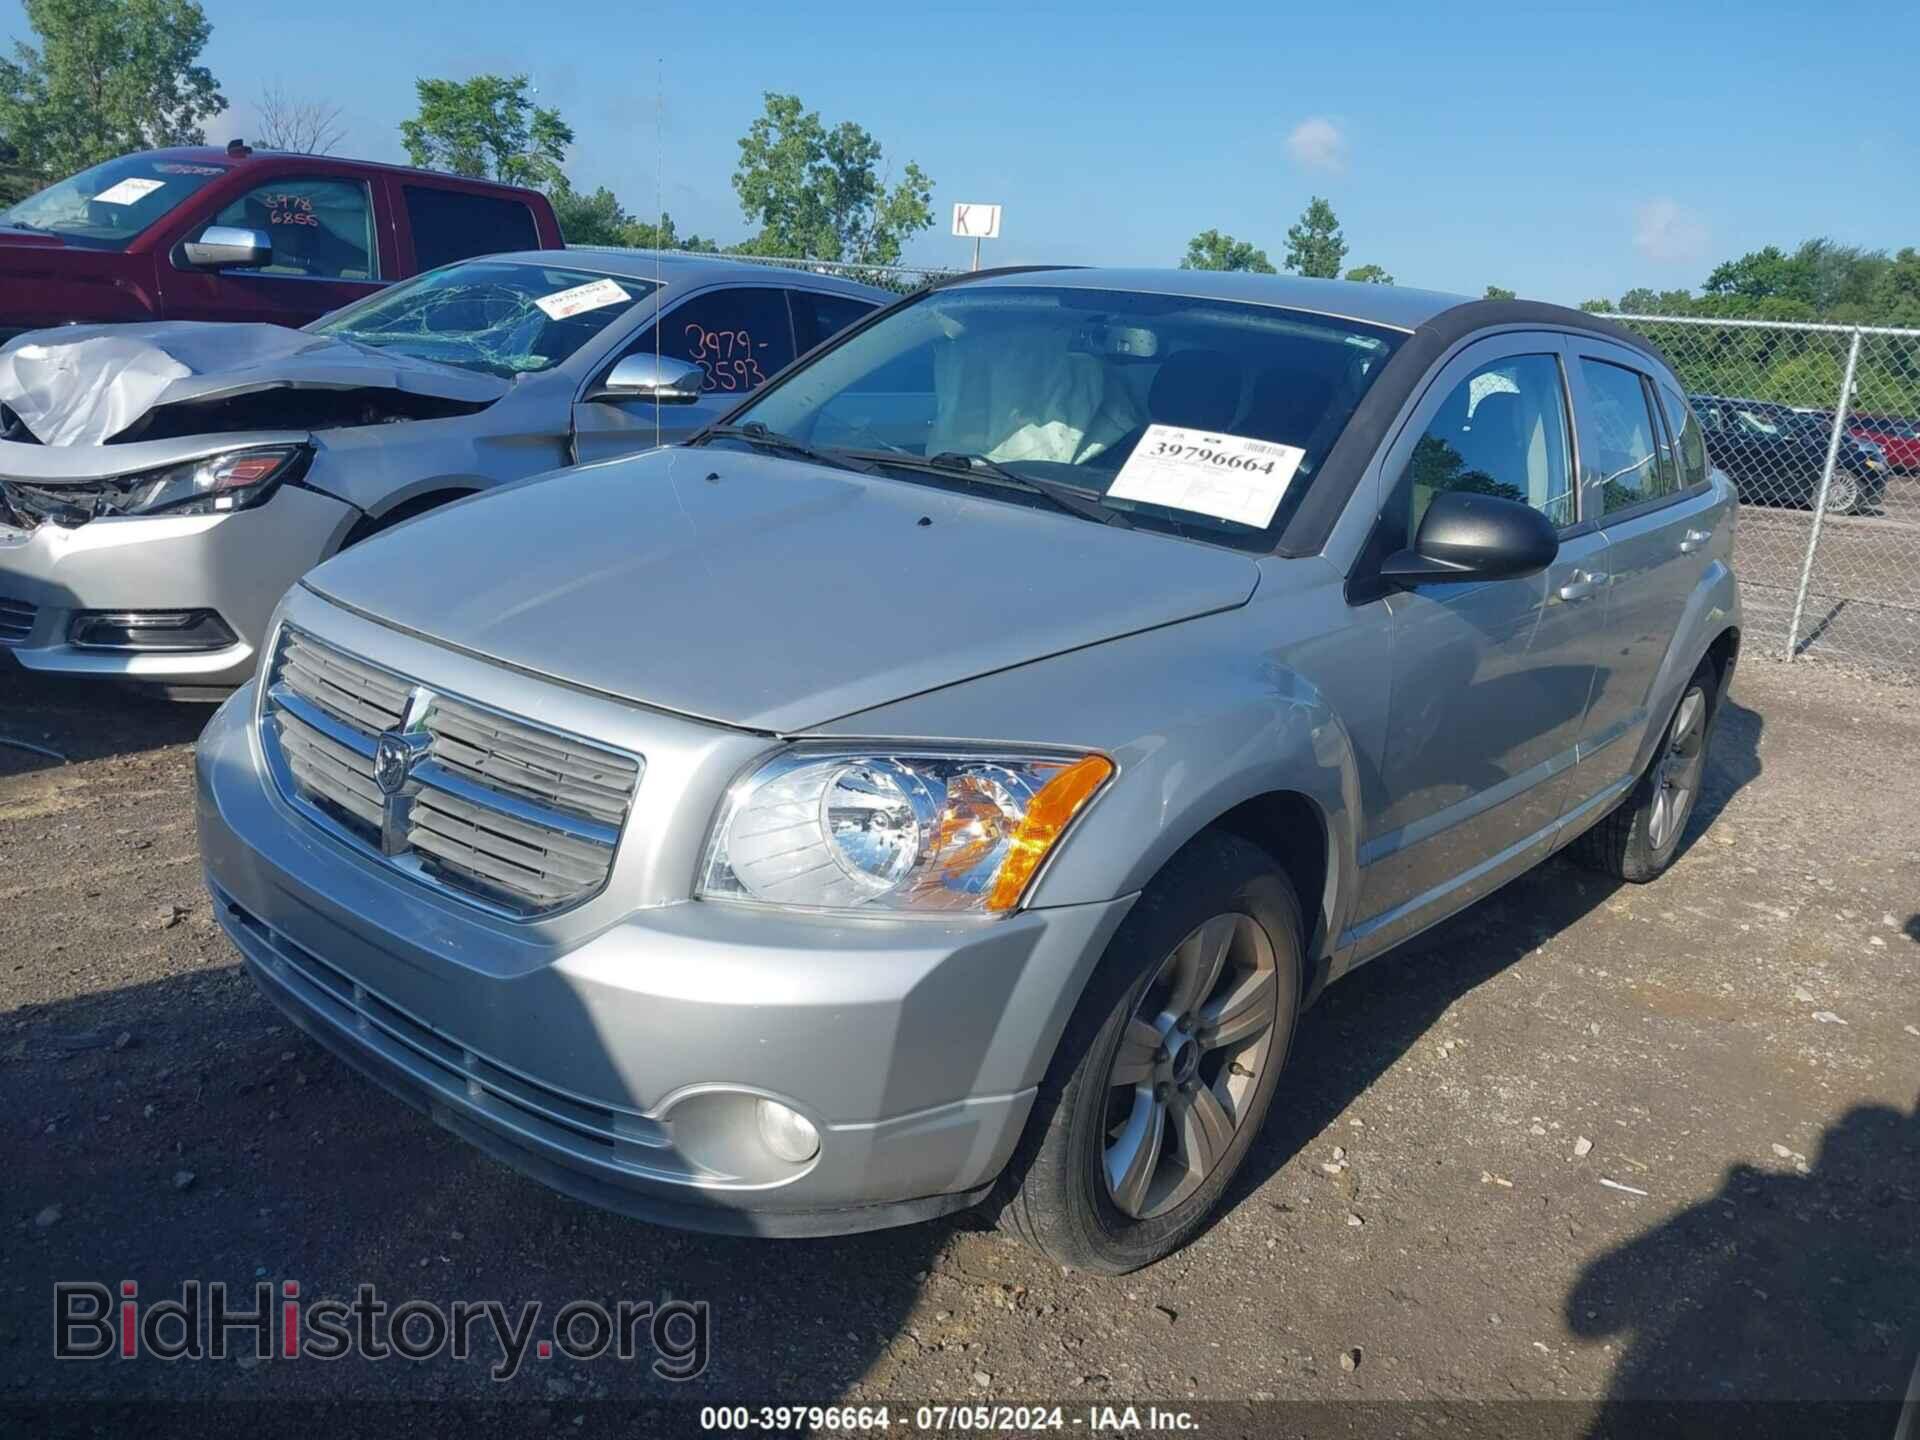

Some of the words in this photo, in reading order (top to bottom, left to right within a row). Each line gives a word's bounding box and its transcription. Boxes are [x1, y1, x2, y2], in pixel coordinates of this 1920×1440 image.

[271, 210, 319, 227] 6855
[957, 206, 971, 234] K
[984, 207, 996, 236] J
[696, 358, 766, 391] 3593
[1149, 441, 1276, 475] 39796664
